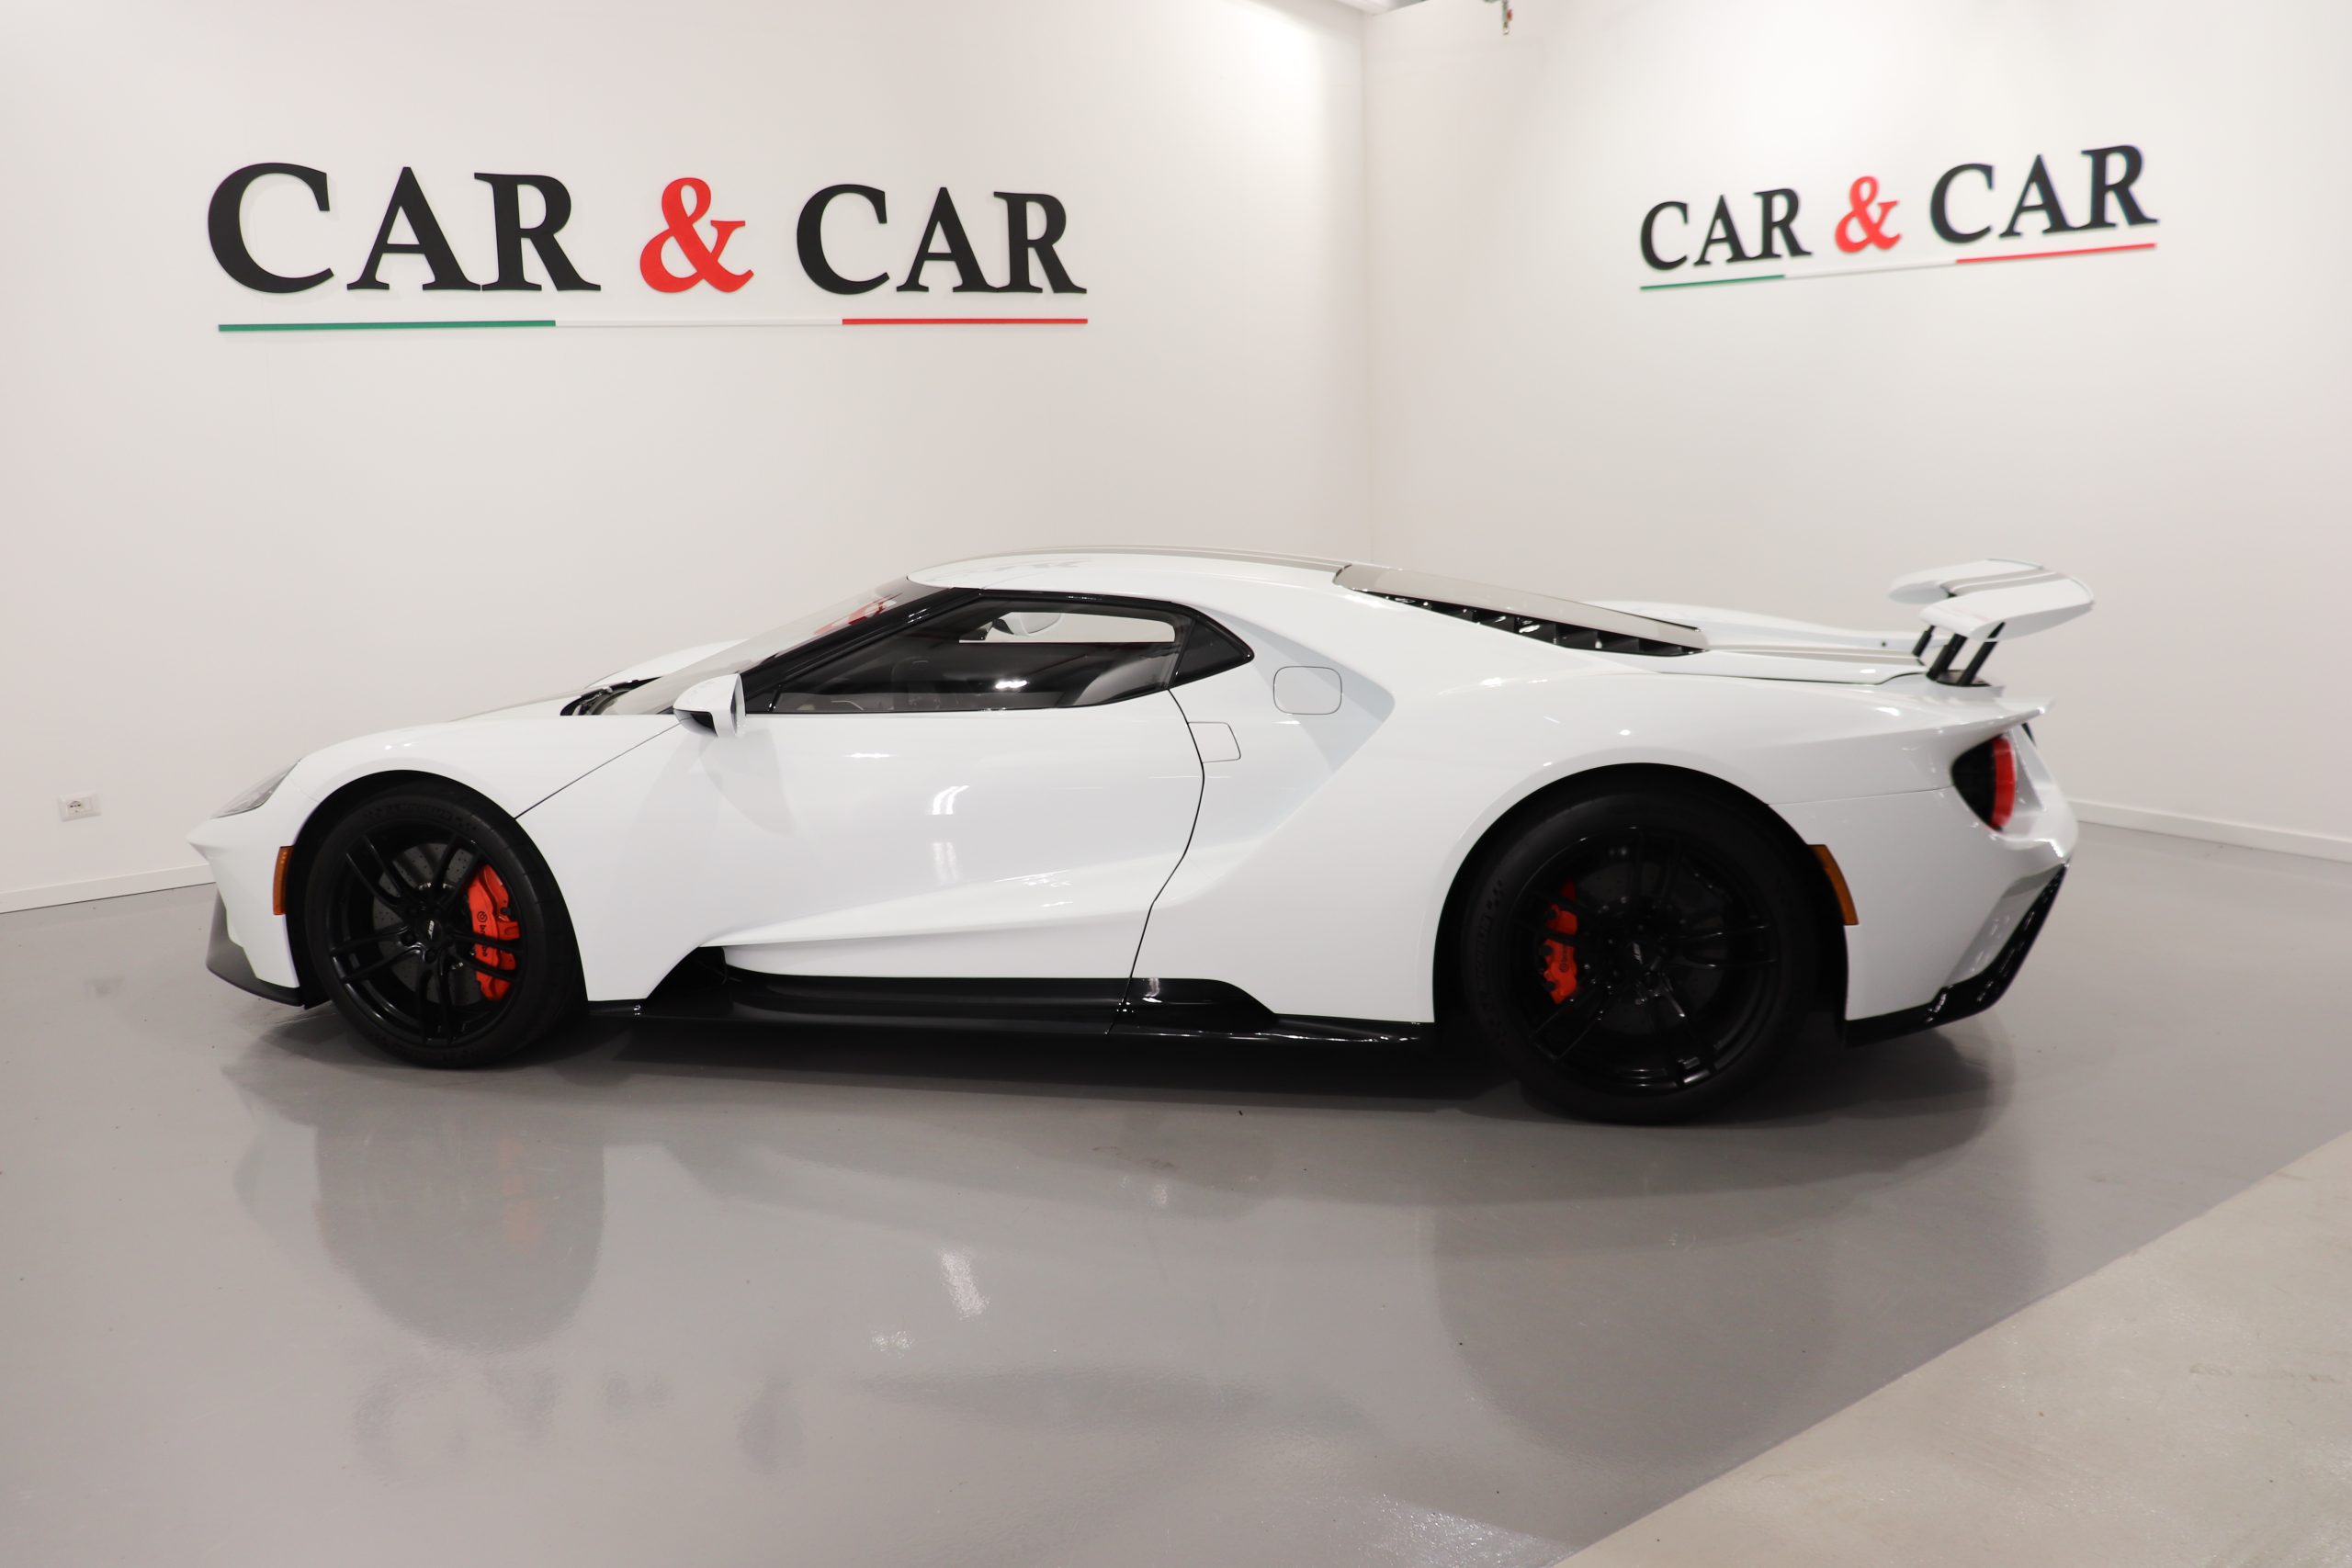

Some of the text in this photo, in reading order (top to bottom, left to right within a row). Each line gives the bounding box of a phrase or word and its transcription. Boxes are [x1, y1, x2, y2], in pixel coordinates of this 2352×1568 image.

[208, 162, 1088, 295] CAR & CAR
[1640, 144, 2159, 271] CAR & CAR
